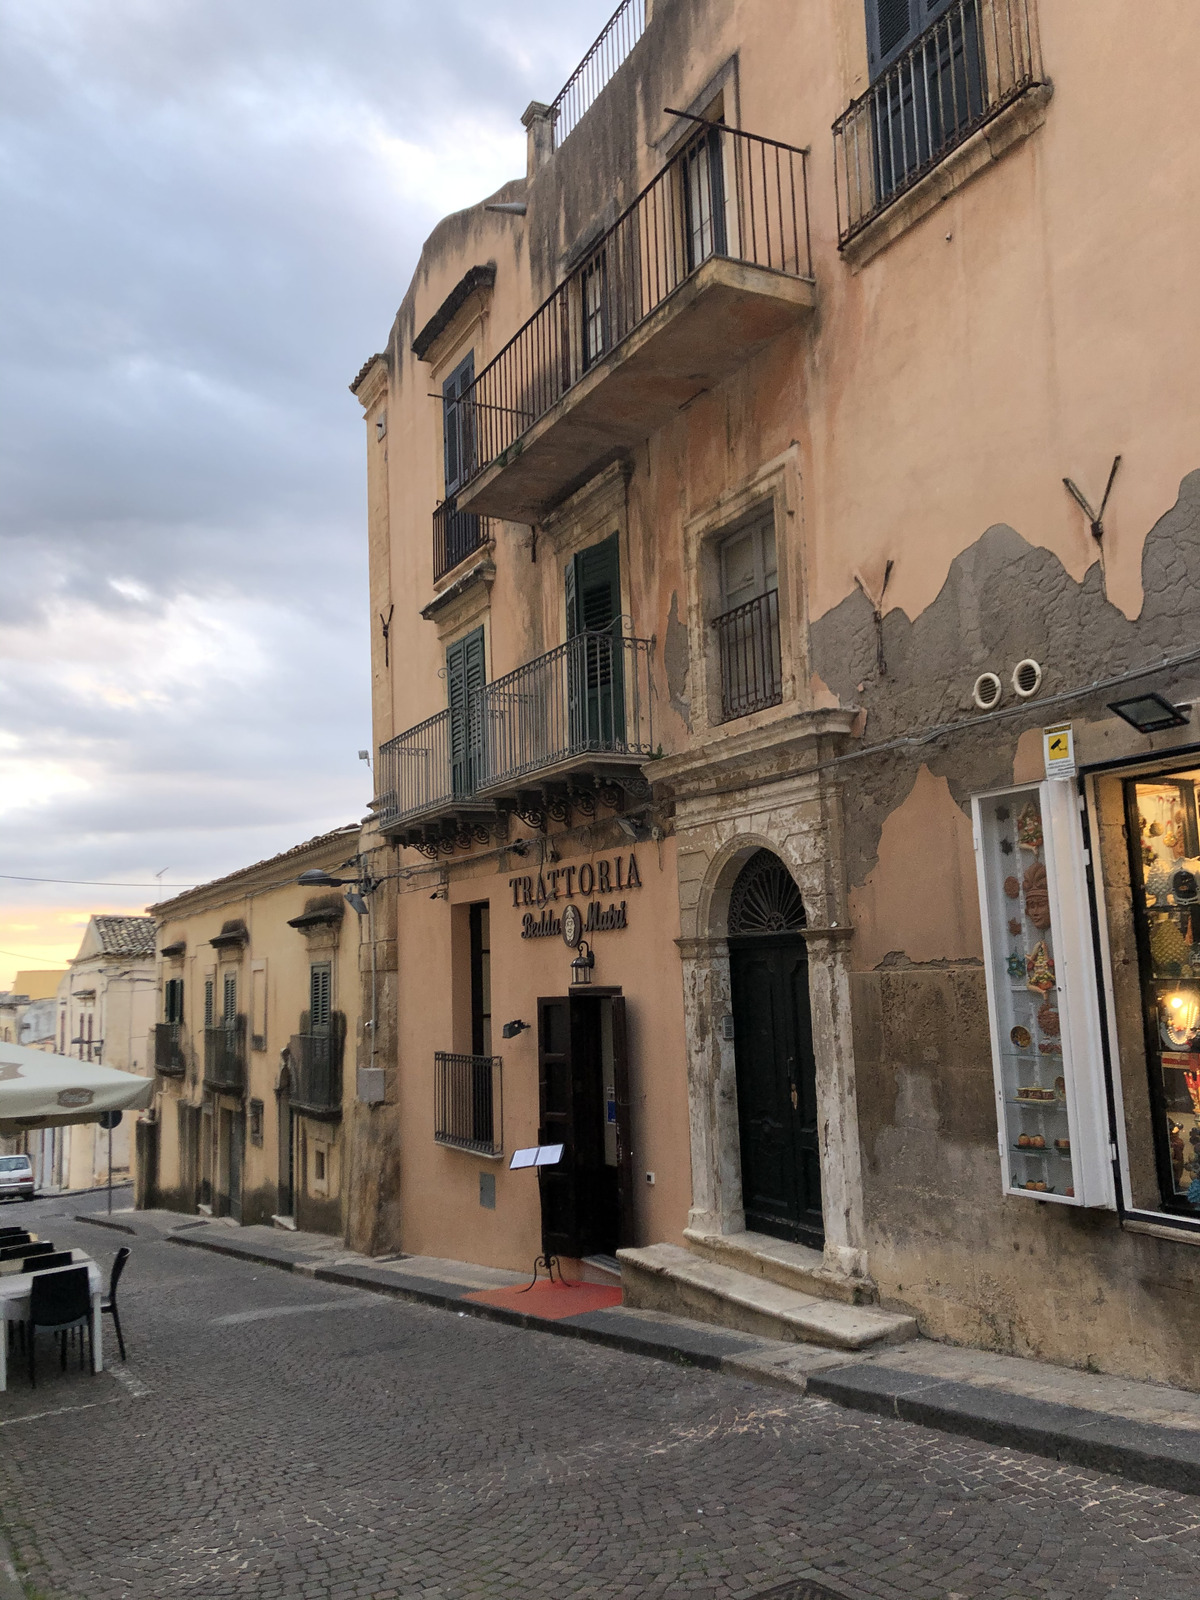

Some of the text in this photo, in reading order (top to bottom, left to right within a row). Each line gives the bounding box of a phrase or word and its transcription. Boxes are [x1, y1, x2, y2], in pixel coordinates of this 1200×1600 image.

[509, 853, 642, 908] TRATTORIA
[521, 901, 628, 939] Bedda Matri
